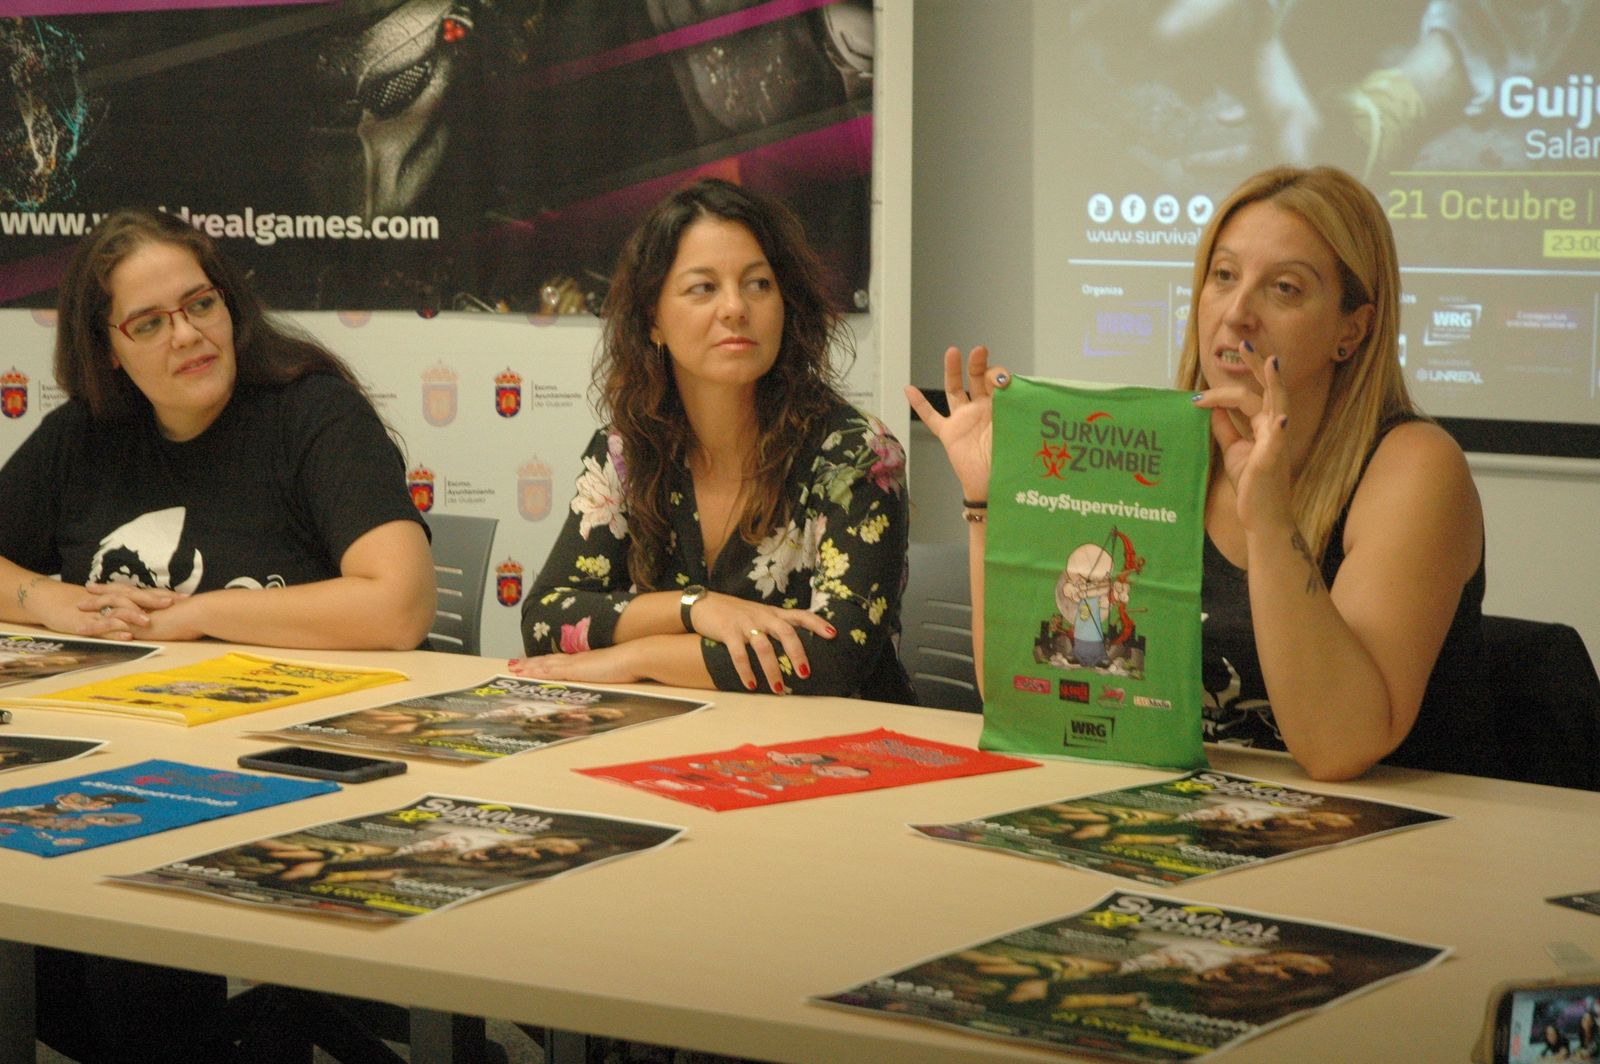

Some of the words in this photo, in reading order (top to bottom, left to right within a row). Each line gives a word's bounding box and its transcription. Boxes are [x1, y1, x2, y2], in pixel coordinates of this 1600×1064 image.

[1499, 74, 1600, 130] Guij
[1387, 189, 1428, 219] 21
[1440, 188, 1577, 220] Octubre
[1433, 310, 1473, 329] WRG
[1040, 409, 1163, 453] SURVIVAL
[1069, 445, 1163, 476] ZOMBIE
[1015, 489, 1178, 524] #SoySuperviviente
[1070, 719, 1108, 738] WRG
[416, 798, 554, 828] SURVIVAL
[1108, 895, 1280, 938] SURVIVAL
